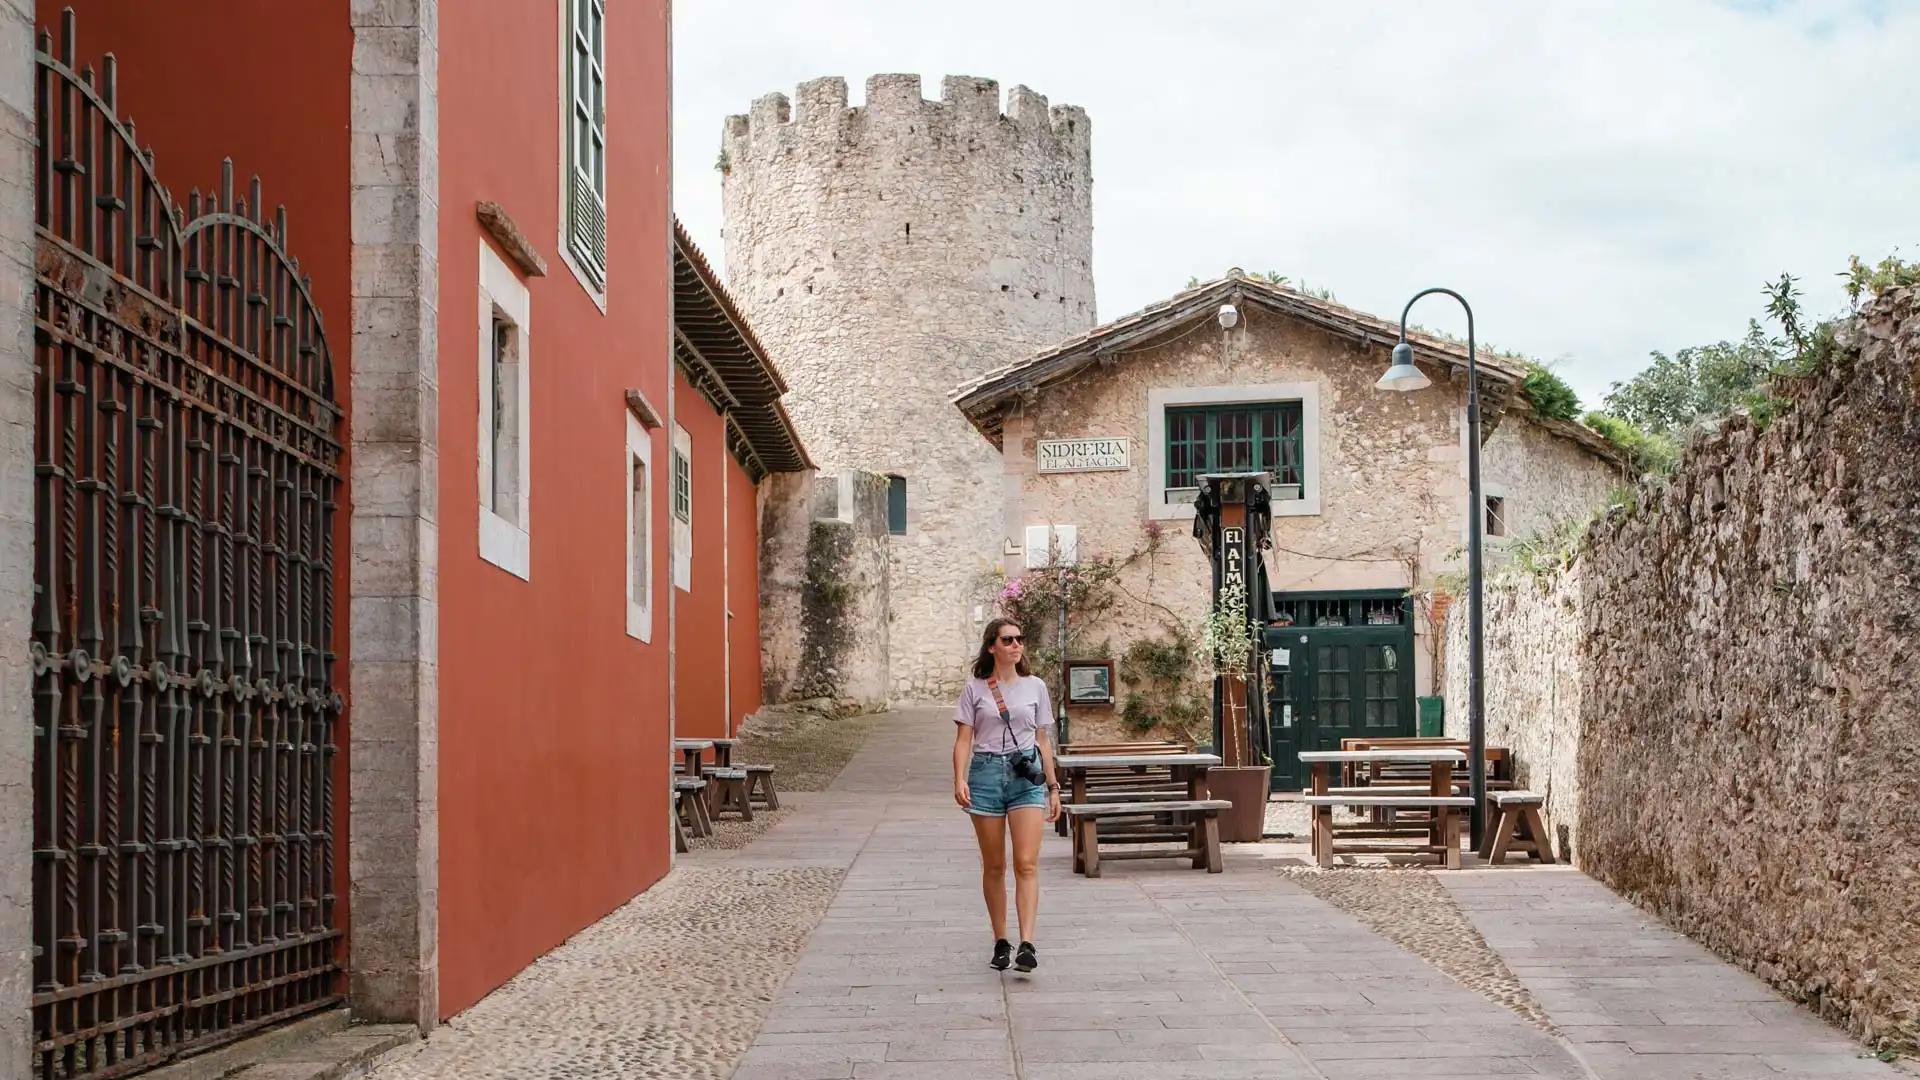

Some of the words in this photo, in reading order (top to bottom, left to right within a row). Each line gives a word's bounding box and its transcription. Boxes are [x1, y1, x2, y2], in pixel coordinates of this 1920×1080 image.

[1042, 442, 1125, 458] SIDRERIA
[1046, 459, 1060, 469] EL
[1225, 531, 1242, 544] EL
